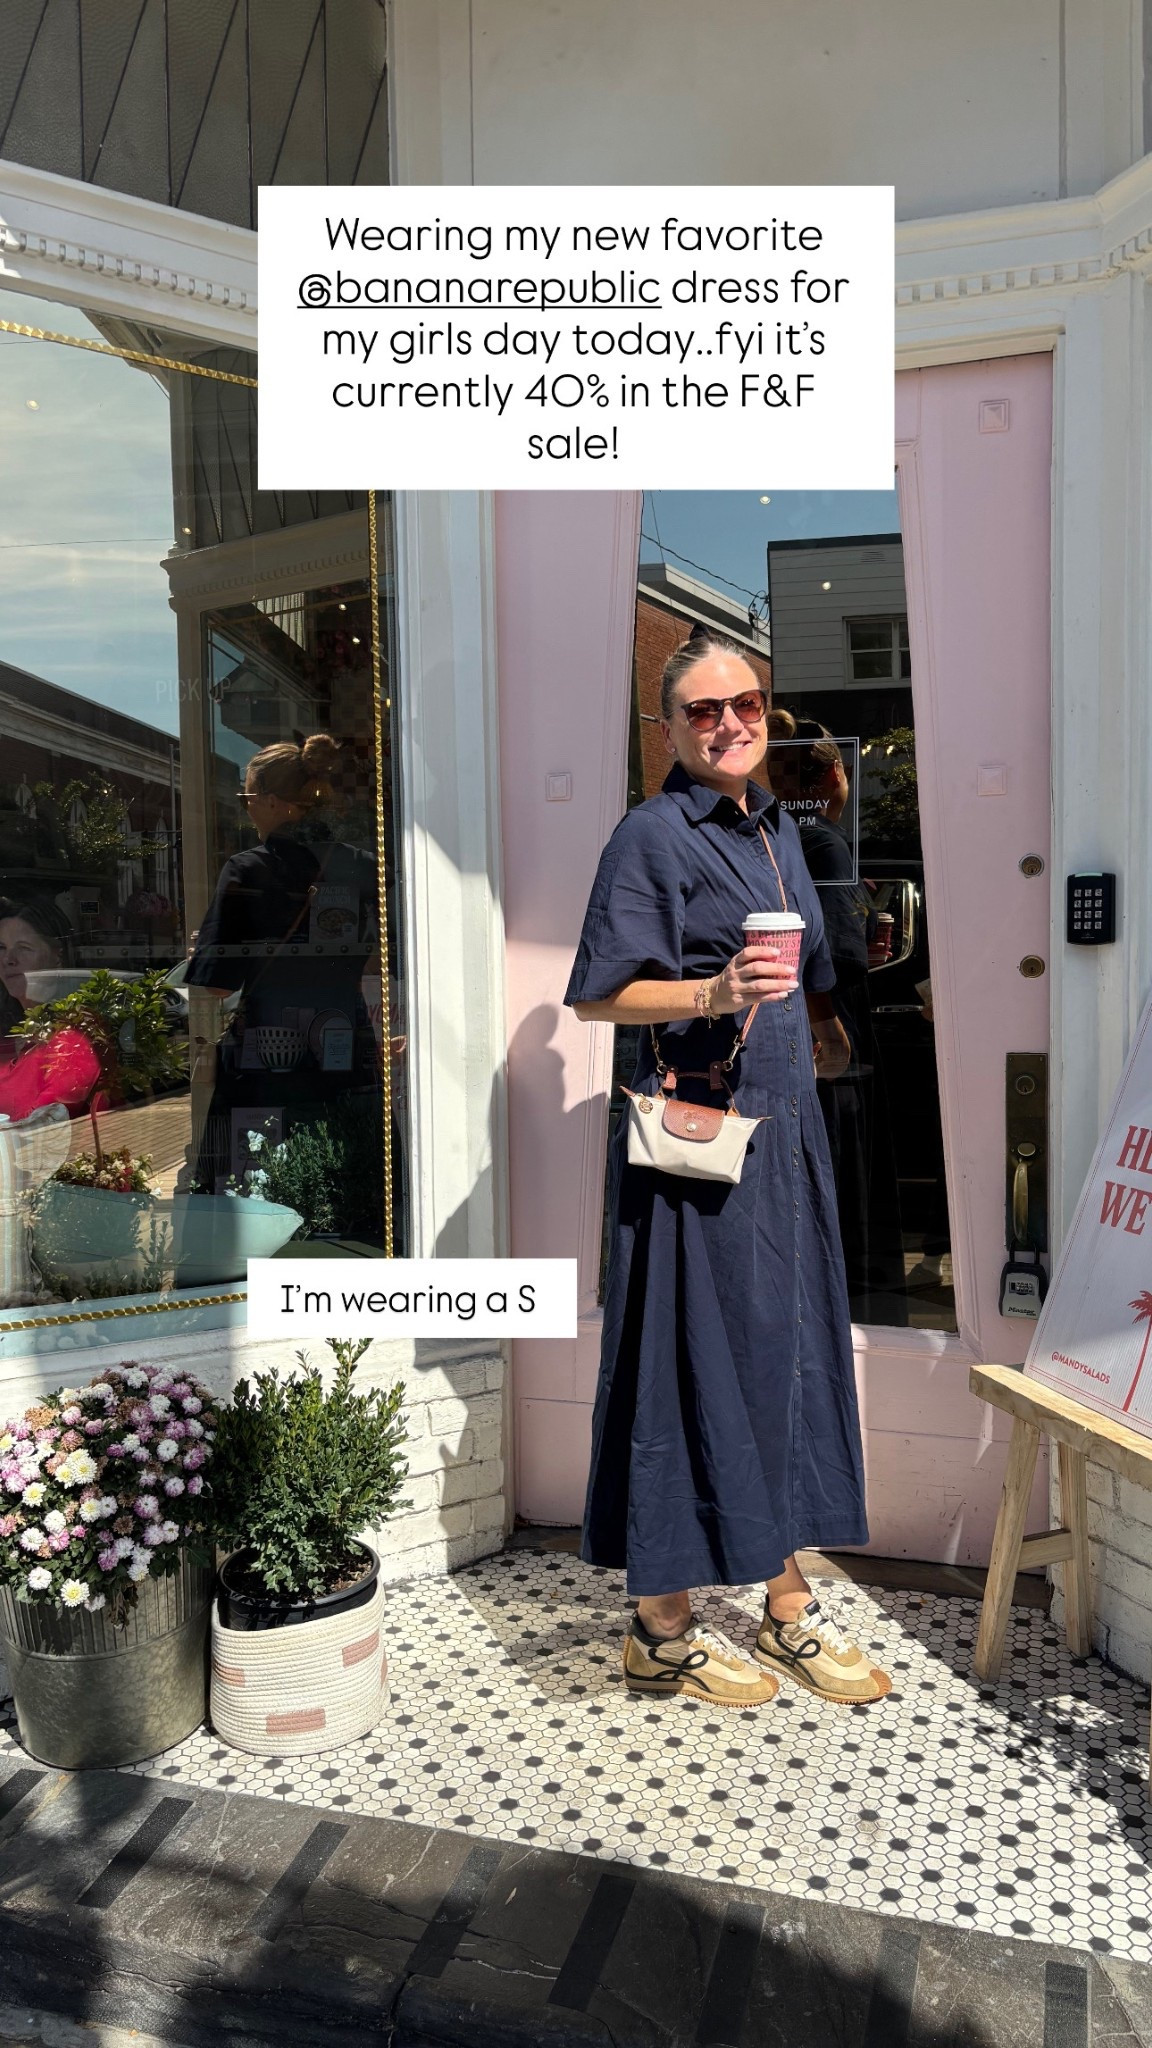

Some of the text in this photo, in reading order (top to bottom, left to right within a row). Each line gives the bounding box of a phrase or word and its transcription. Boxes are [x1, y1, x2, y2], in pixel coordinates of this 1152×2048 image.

[155, 677, 232, 702] PICK UP
[780, 799, 831, 811] SUNDAY
[799, 816, 816, 826] PM
[1100, 1181, 1152, 1236] WE
[1052, 1351, 1111, 1384] @MANDYSALADS
